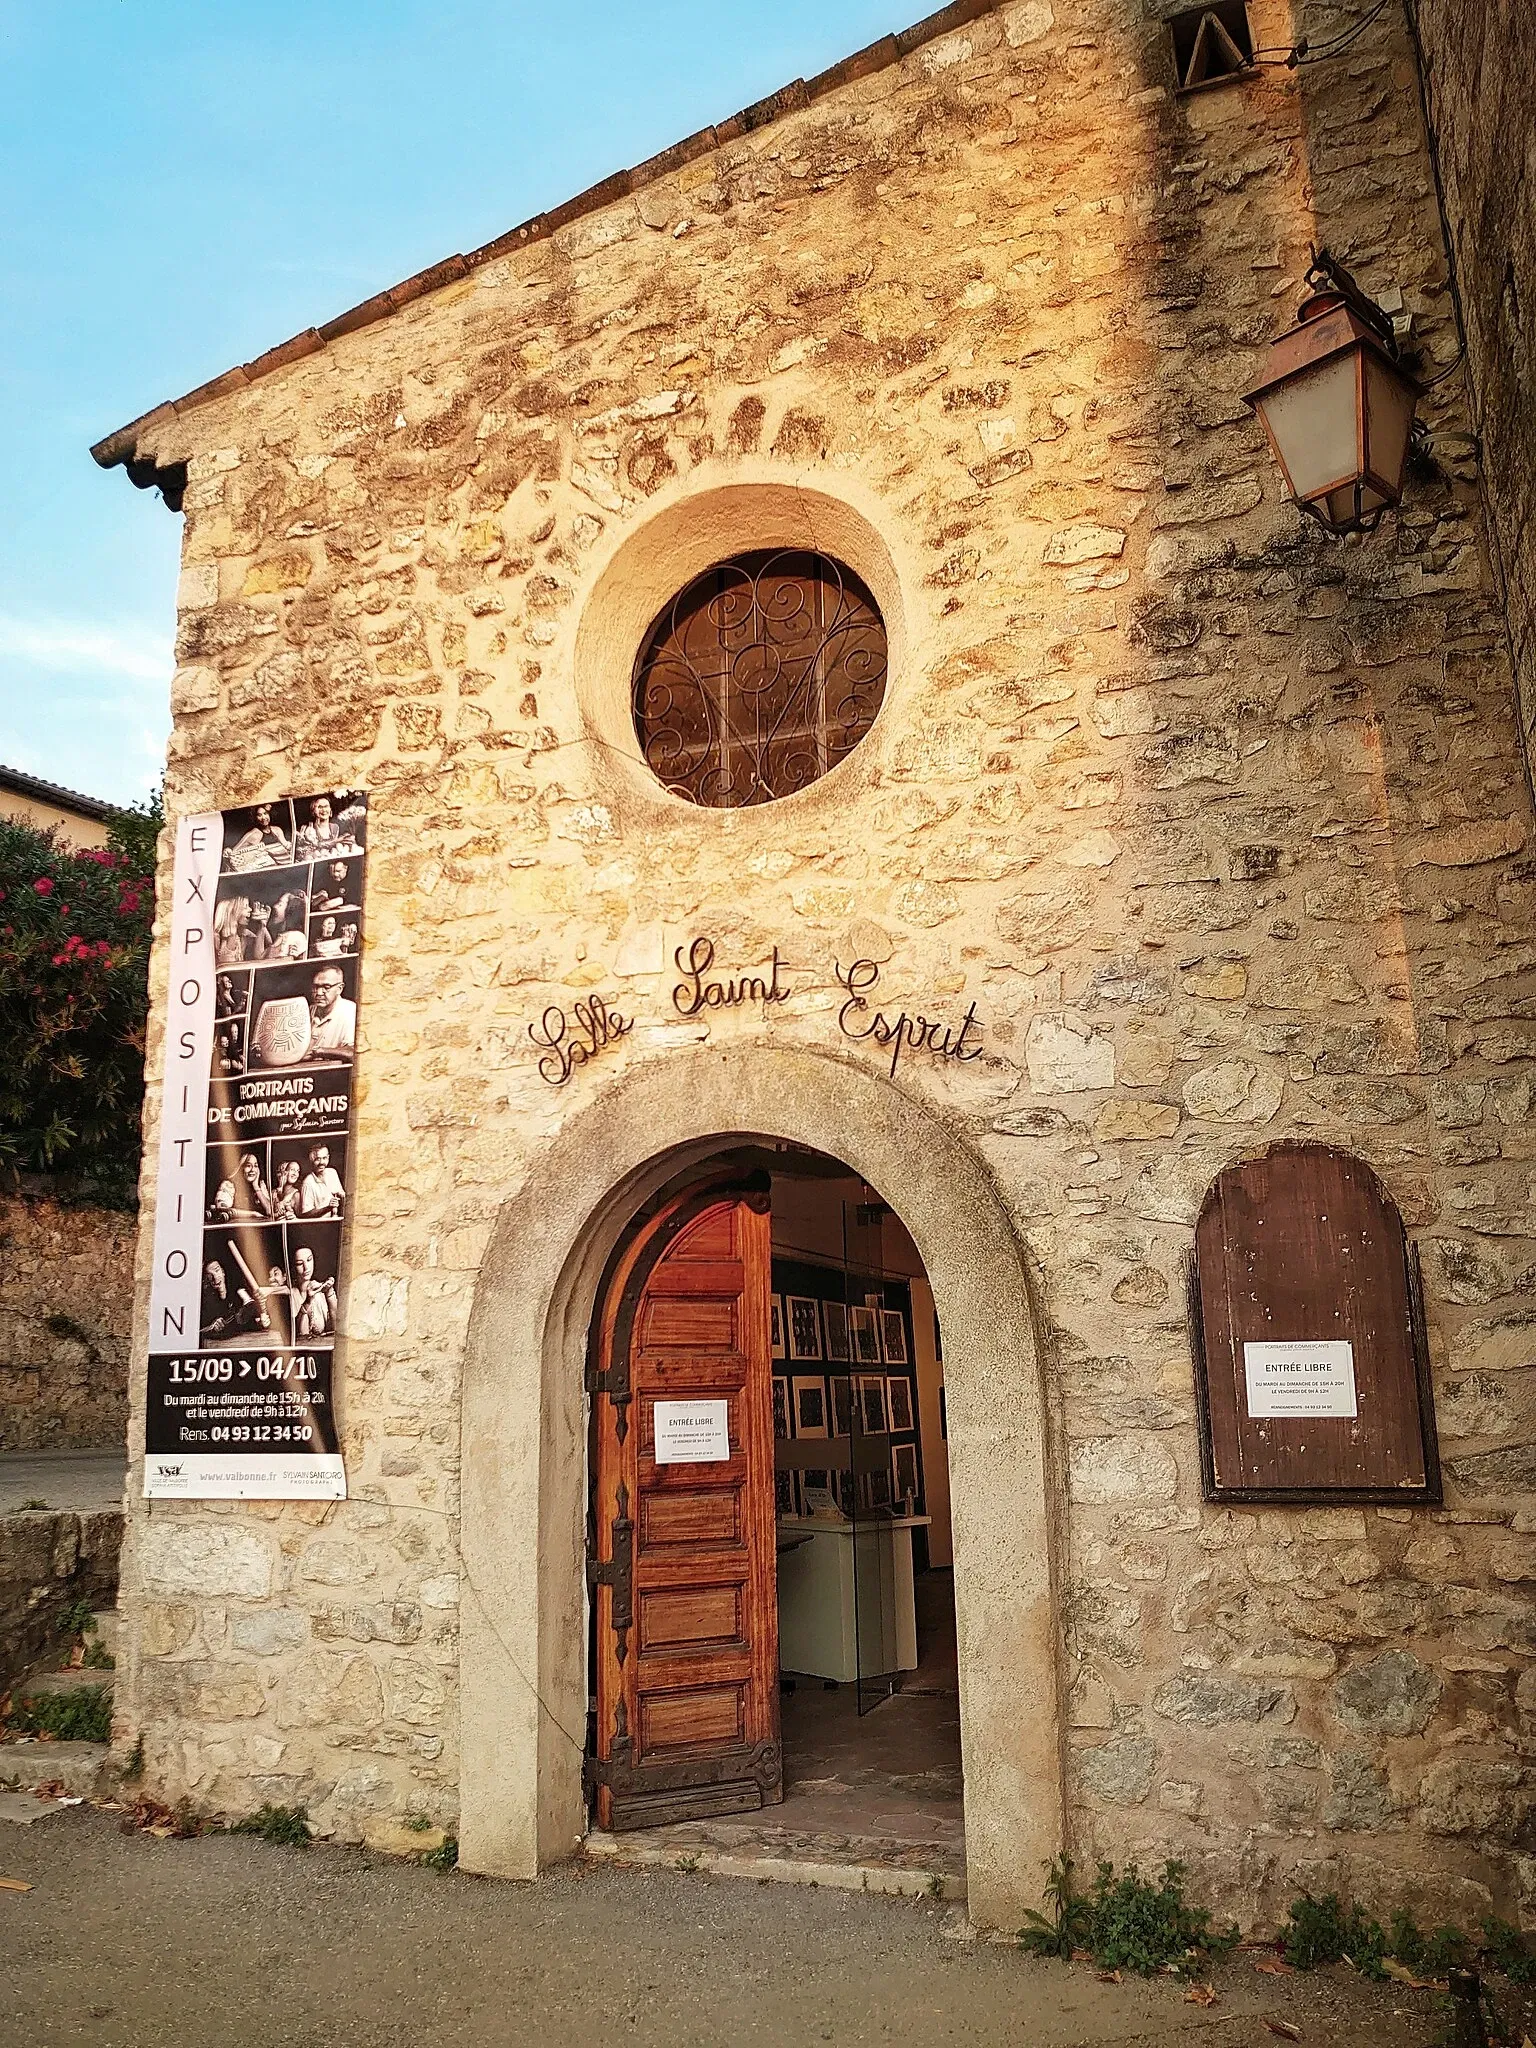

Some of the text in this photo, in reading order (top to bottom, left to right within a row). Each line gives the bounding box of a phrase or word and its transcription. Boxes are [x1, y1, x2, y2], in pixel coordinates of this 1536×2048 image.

[528, 937, 985, 1085] Salle Saint Esprit
[163, 826, 207, 1336] EXPOSITION
[240, 1077, 313, 1100] PORTRAITS
[208, 1095, 348, 1123] DE COMMERÇANTS
[169, 1359, 233, 1382] 15/09
[256, 1356, 317, 1381] 04/10
[1265, 1362, 1333, 1372] ENTRÉE LIBRE
[163, 1395, 178, 1406] Du
[179, 1393, 206, 1405] mardi
[207, 1395, 219, 1405] au
[220, 1392, 265, 1405] dimanche
[266, 1392, 279, 1404] de
[279, 1391, 300, 1403] 15h
[302, 1391, 311, 1403] à
[186, 1404, 308, 1418] et le vendredi de 9h à 12h
[669, 1417, 693, 1426] ENTRÉE
[179, 1425, 313, 1441] Rens. 04 93 12 34 50
[200, 1471, 277, 1481] www.valbonne.fr
[309, 1471, 343, 1479] SANTORO
